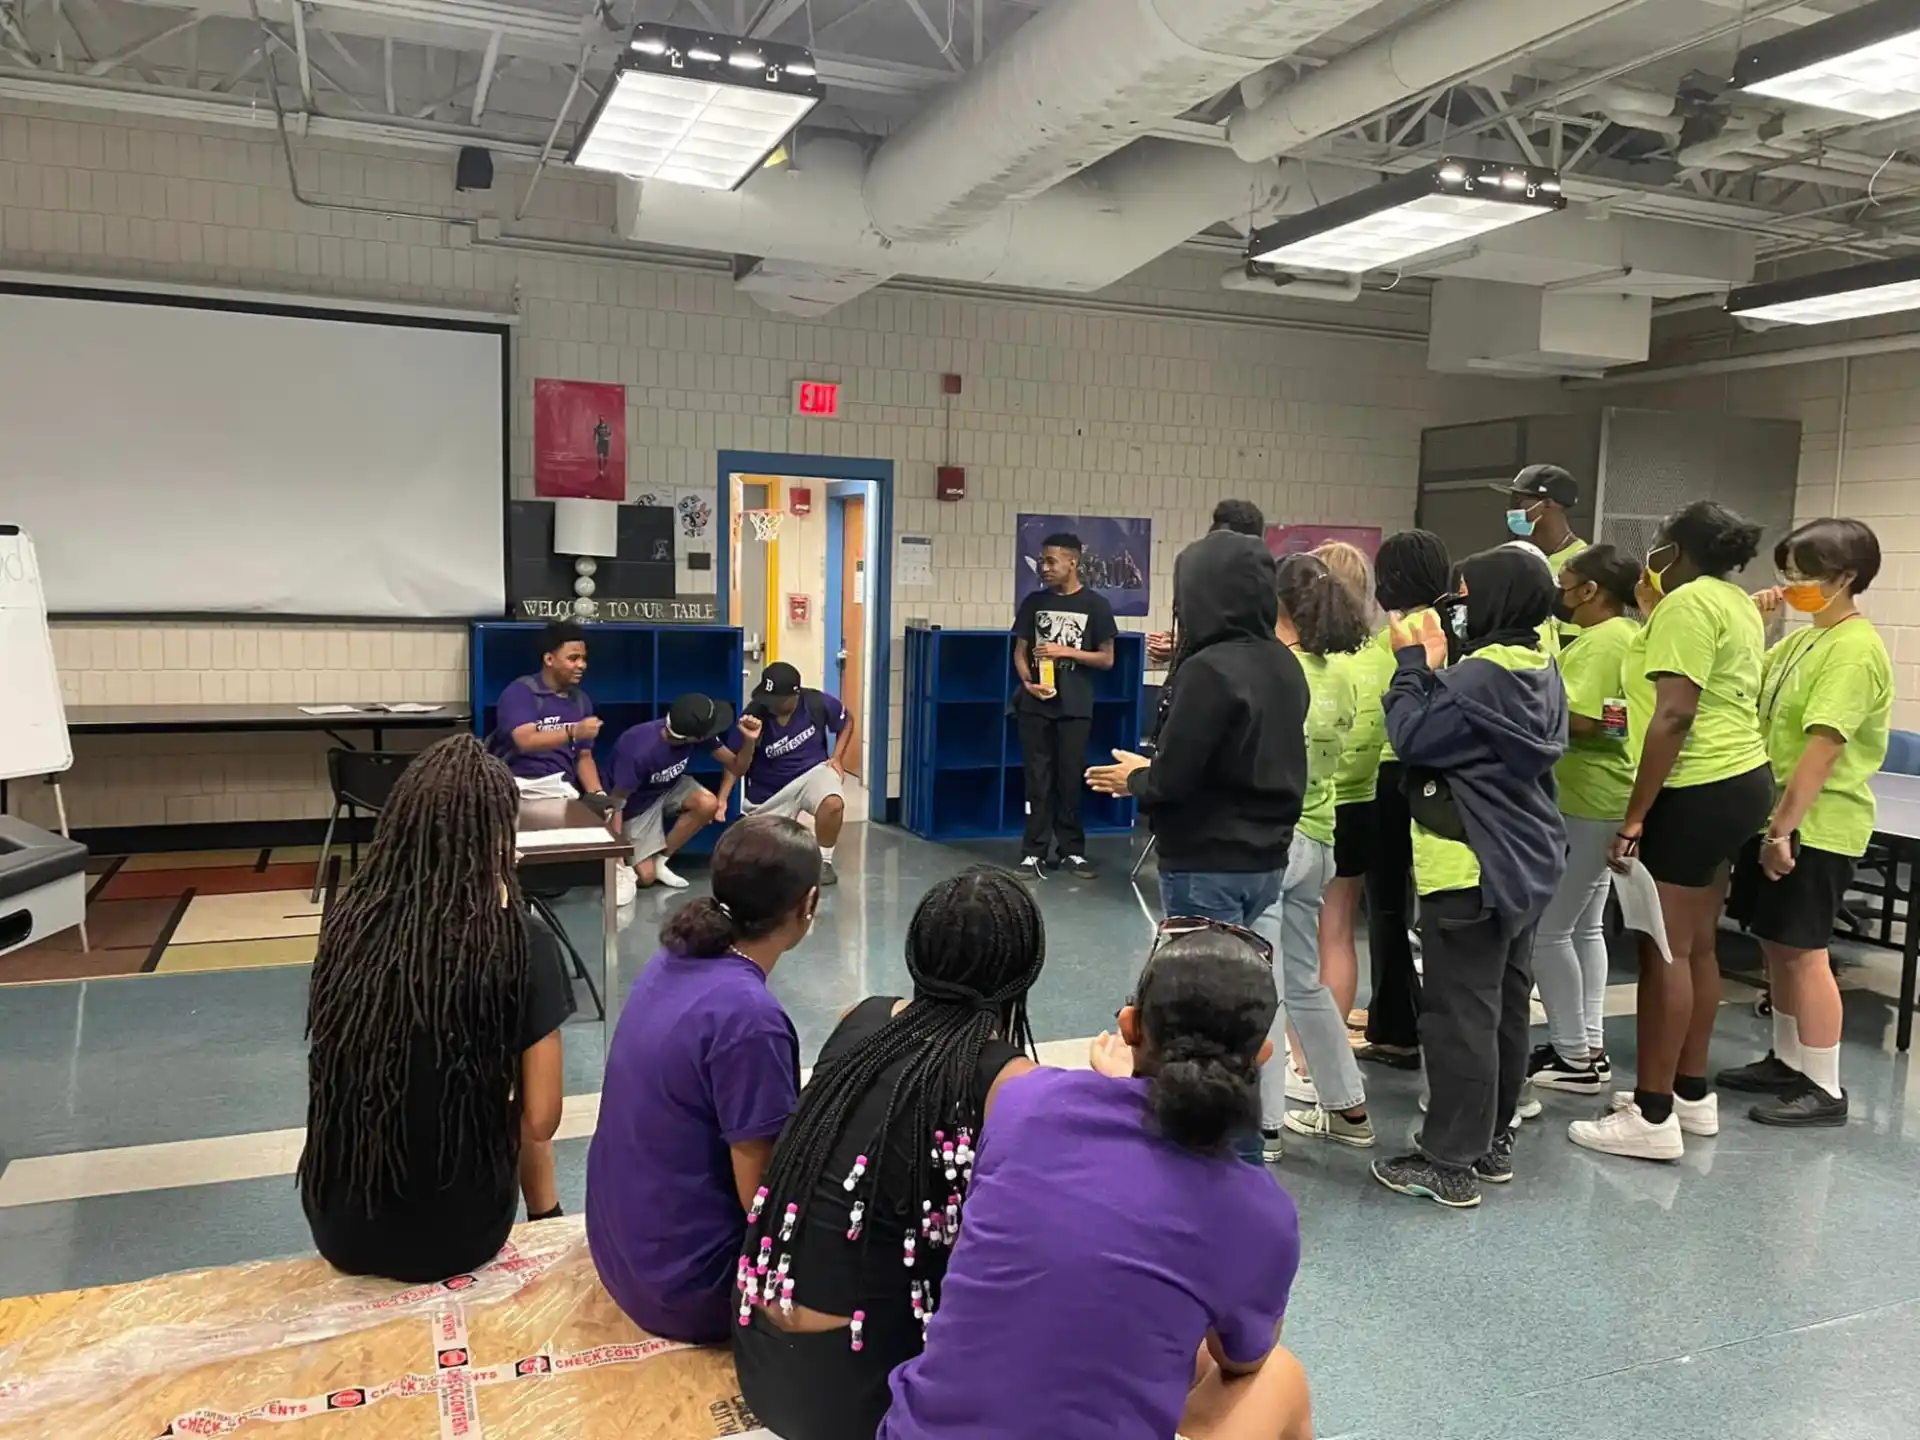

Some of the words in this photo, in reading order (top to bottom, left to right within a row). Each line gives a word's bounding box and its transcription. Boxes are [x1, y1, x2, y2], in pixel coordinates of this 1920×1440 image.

[800, 382, 837, 414] EXIT
[522, 600, 599, 619] WELCOE
[607, 601, 630, 618] TO
[634, 601, 666, 619] OUR
[671, 603, 715, 620] TABLE
[765, 678, 774, 692] B
[555, 1352, 602, 1370] CHECK
[178, 1416, 221, 1434] CHECK
